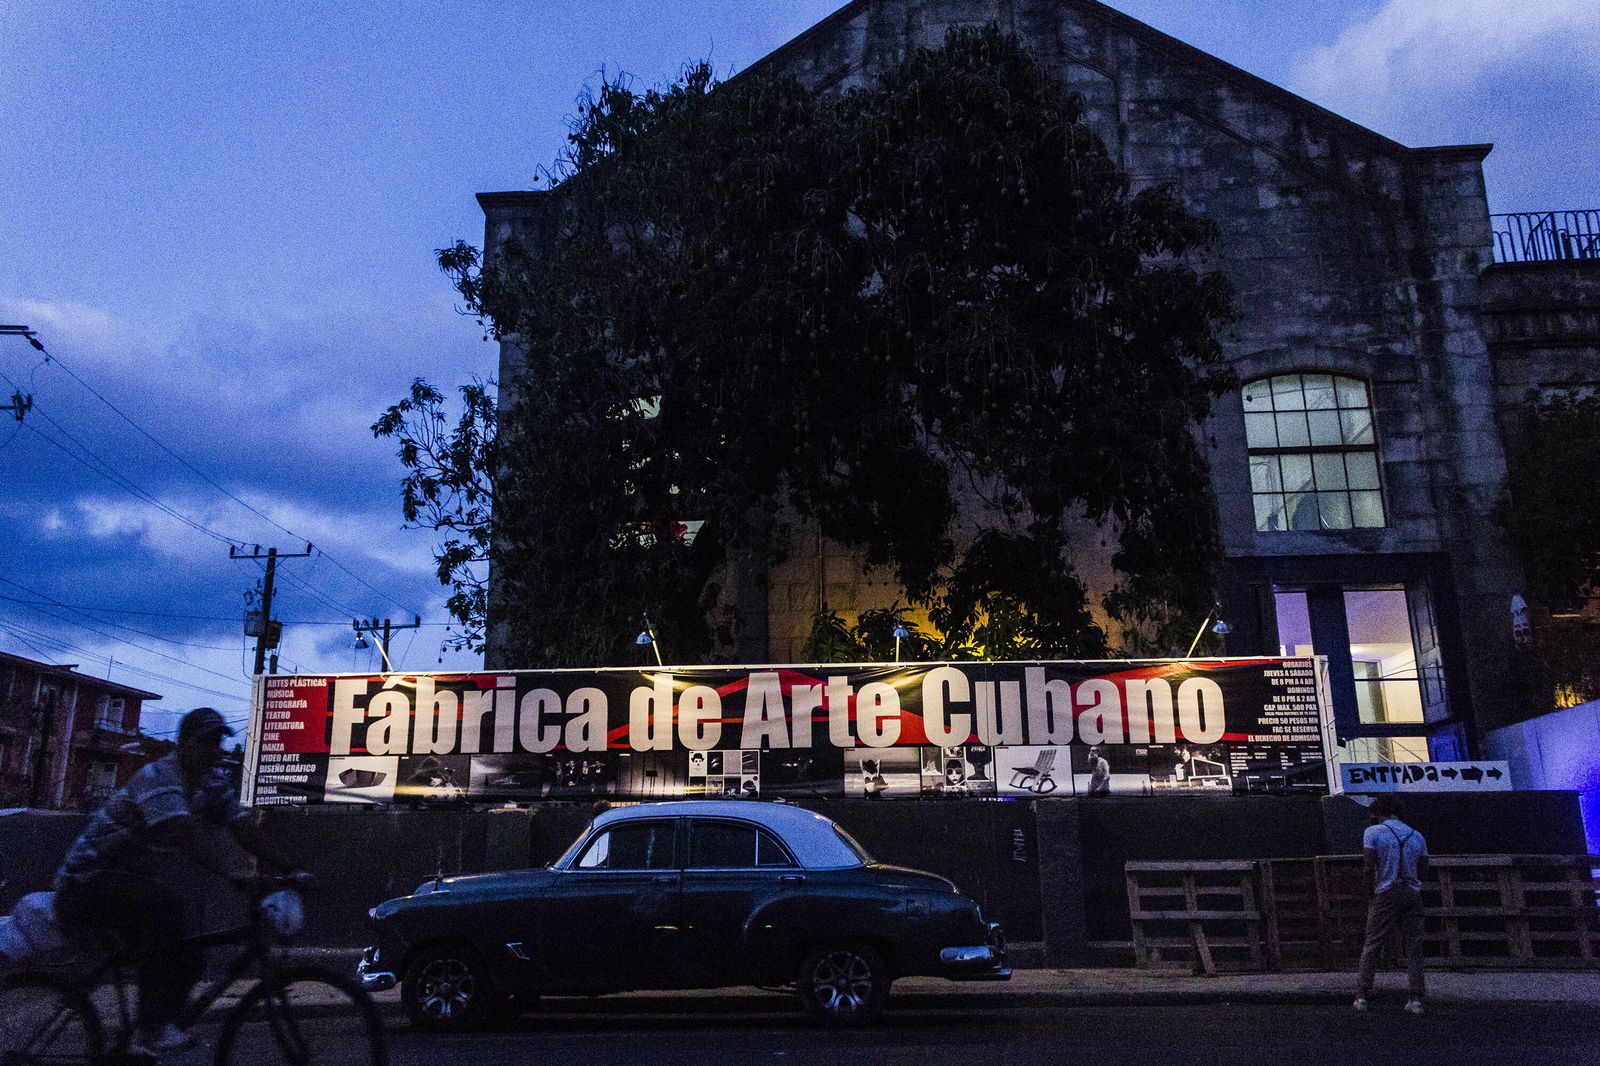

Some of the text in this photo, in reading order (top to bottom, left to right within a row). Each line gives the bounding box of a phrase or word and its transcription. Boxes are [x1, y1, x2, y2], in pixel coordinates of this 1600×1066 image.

[1263, 669, 1284, 677] JUEVES
[267, 678, 327, 687] ARTES PLÁSTICAS
[266, 689, 294, 698] MÚSICA
[266, 699, 308, 708] FOTOGRAFÍA
[265, 711, 291, 720] TEATRO
[330, 666, 1226, 756] Fábrica de Arte Cubano
[1258, 717, 1279, 725] PRECIO
[264, 722, 305, 730] LITERATURA
[263, 733, 280, 741] CINE
[262, 743, 285, 751] DANZA
[261, 754, 300, 762] VIDEO ARTE
[259, 763, 316, 773] DISEÑO GRÁFICO
[258, 775, 308, 784] INTERIORISMO
[256, 786, 278, 794] MODA
[255, 796, 307, 805] ARQUITECTURA
